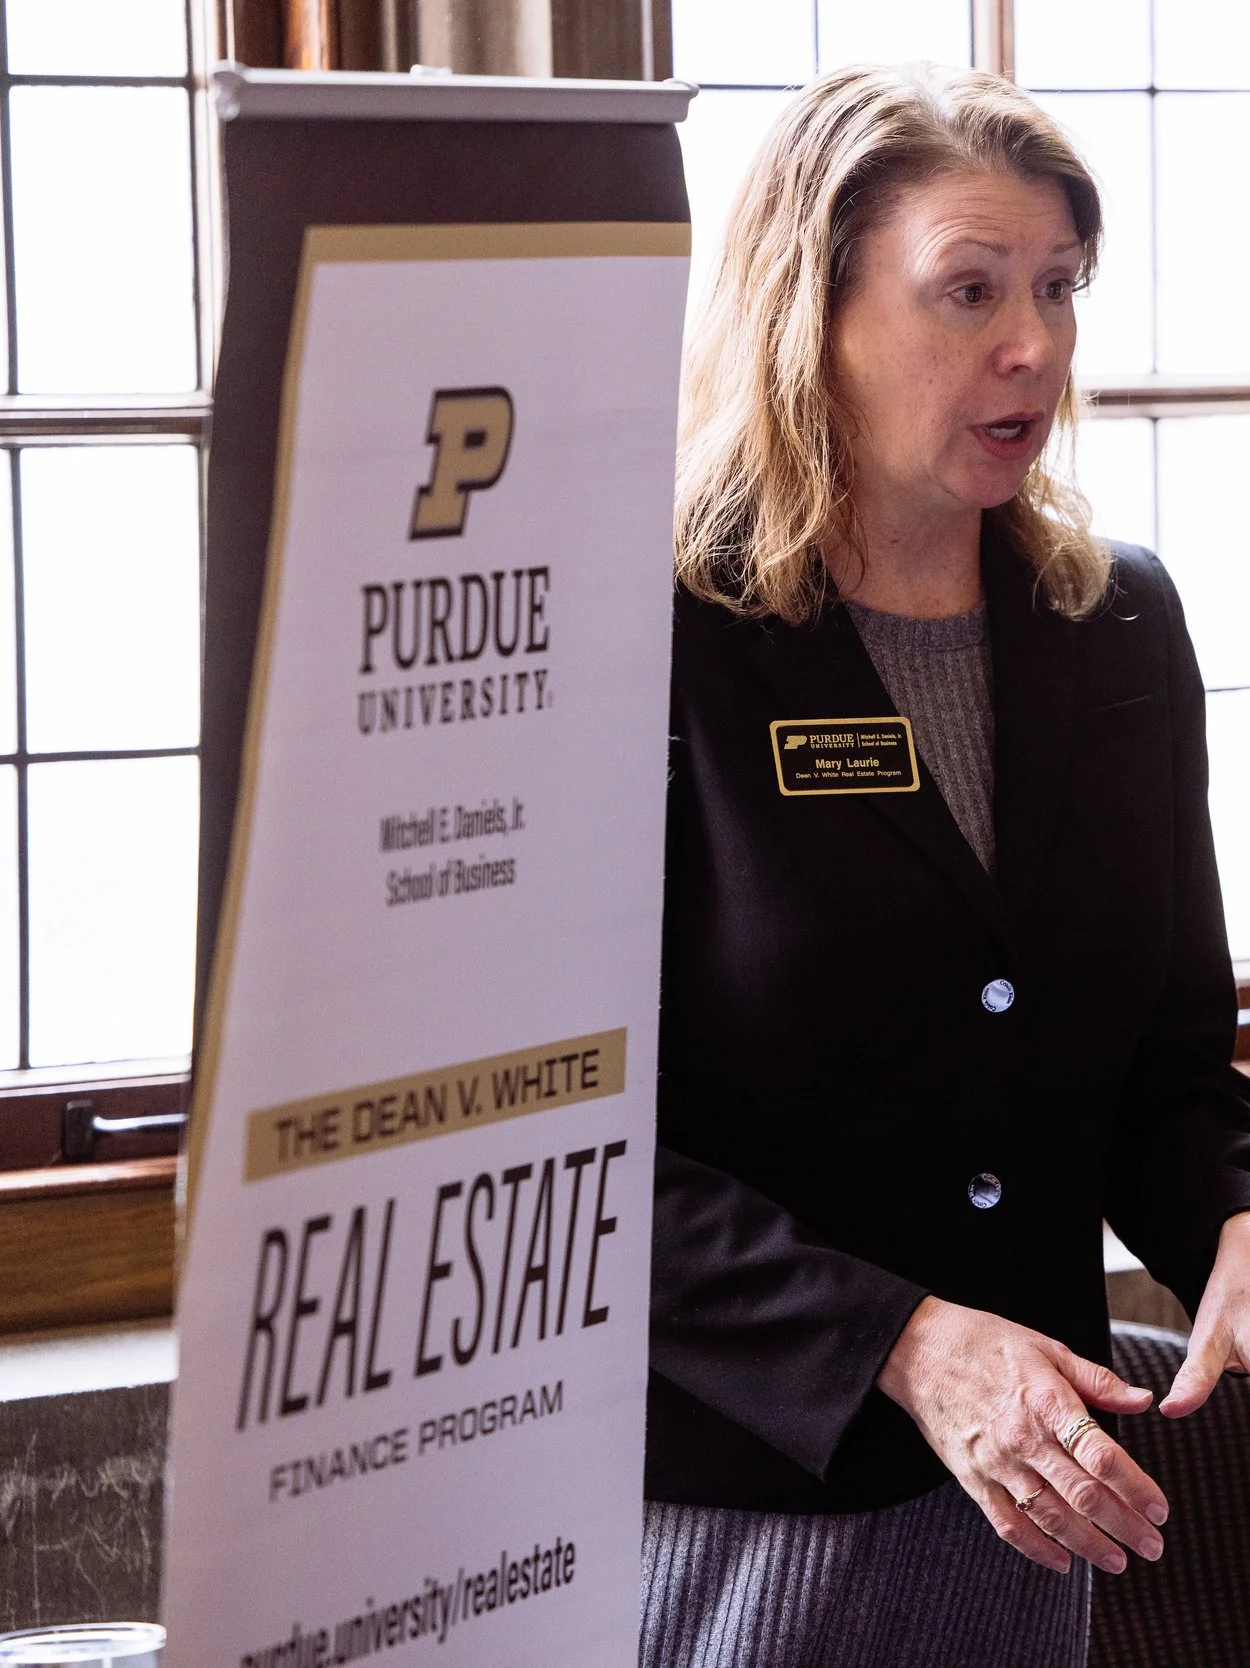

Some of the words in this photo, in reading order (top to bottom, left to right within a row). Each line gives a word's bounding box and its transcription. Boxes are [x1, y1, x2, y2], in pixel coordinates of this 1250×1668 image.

[408, 386, 516, 541] P
[357, 566, 551, 675] PURDUE
[357, 669, 549, 735] UNIVERSITY
[809, 734, 855, 744] PURDUE
[815, 758, 842, 771] Mary
[846, 756, 880, 768] Laurie
[380, 806, 434, 852] Mitchell
[384, 861, 434, 906] School
[438, 859, 452, 896] of
[454, 853, 515, 893] Business
[275, 1107, 342, 1163] THE
[353, 1083, 448, 1144] DEAN
[457, 1074, 483, 1118] V.
[491, 1049, 600, 1110] WHITE
[235, 1198, 398, 1433] REAL
[413, 1138, 628, 1379] ESTATE
[268, 1429, 409, 1501] FINANCE
[418, 1380, 565, 1456] PROGRAM
